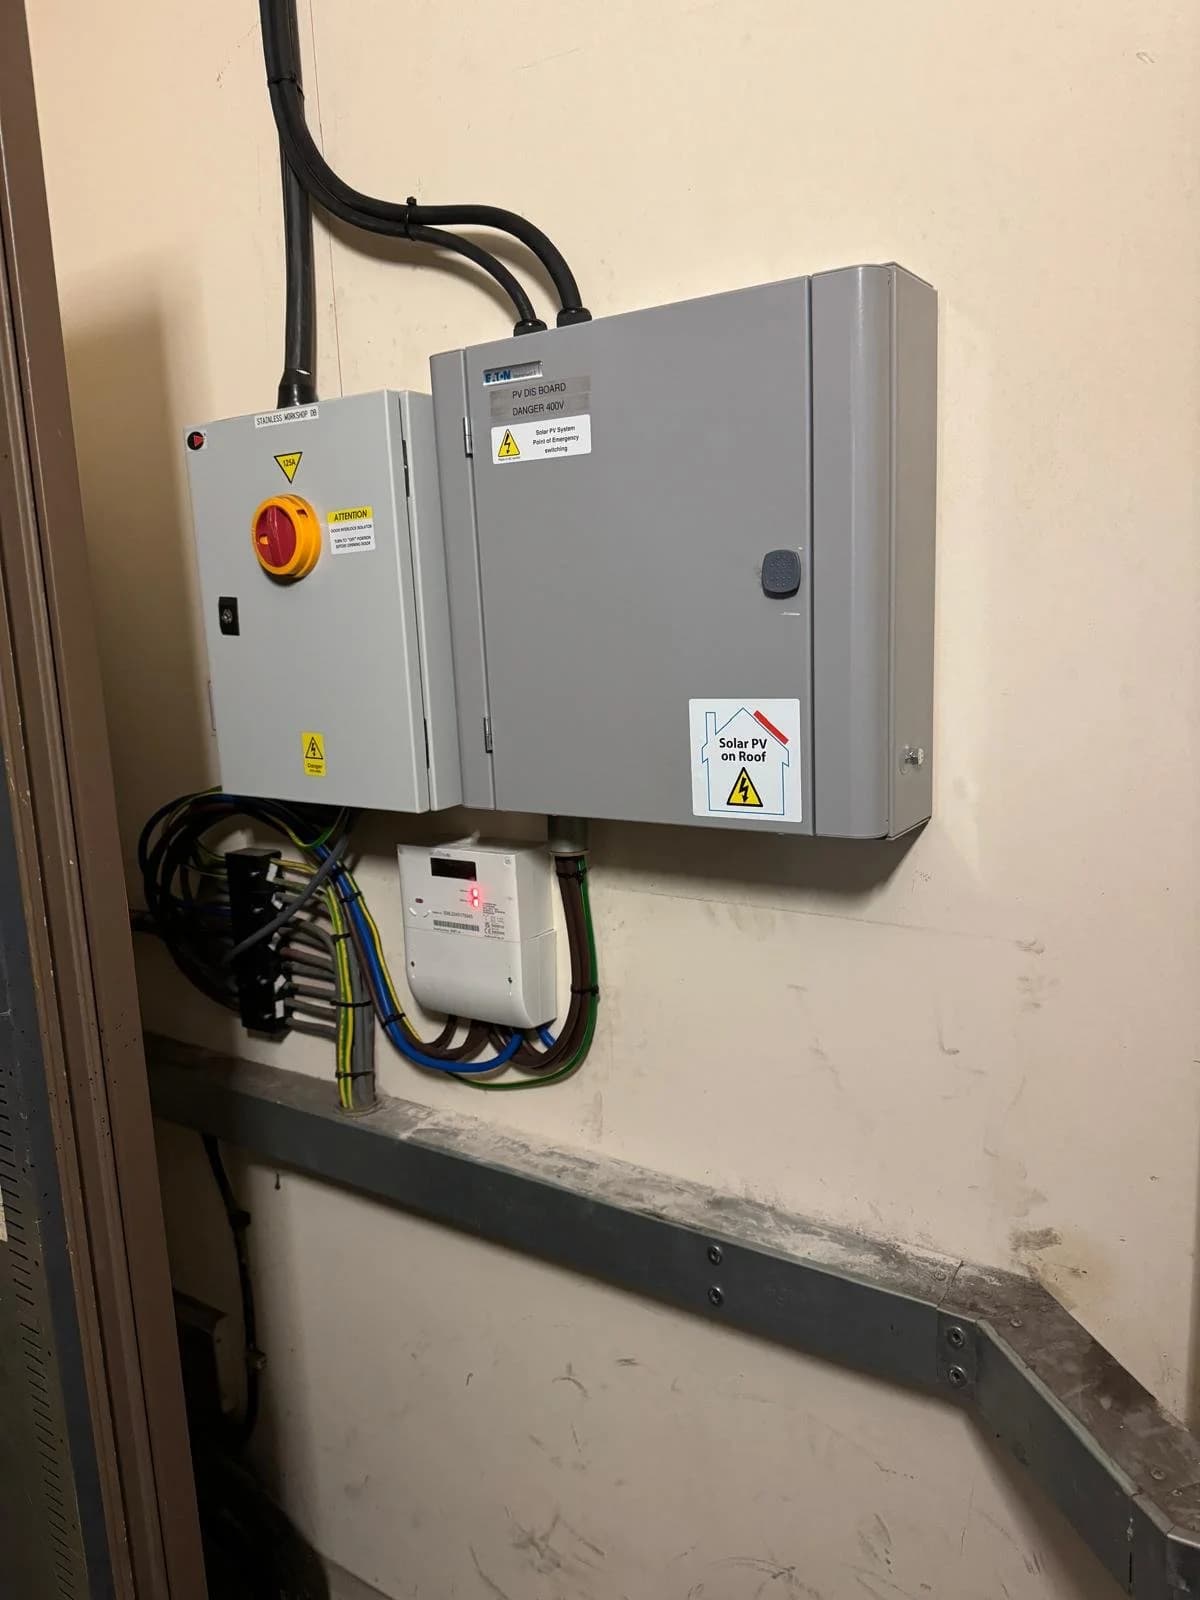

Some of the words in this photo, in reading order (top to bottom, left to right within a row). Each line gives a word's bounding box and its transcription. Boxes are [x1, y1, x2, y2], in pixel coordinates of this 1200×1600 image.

[512, 390, 523, 400] PV
[524, 387, 537, 398] DIS
[538, 382, 567, 395] BOARD
[512, 403, 545, 416] DANGER
[546, 400, 565, 412] 400V
[256, 414, 282, 426] STAINLESS
[284, 410, 308, 421] WORKSHOP
[557, 425, 576, 434] System
[552, 434, 580, 443] Emergency
[544, 446, 568, 454] switching
[282, 459, 296, 468] 125A
[334, 509, 368, 521] ATTENTION
[719, 737, 749, 749] Solar
[752, 738, 768, 750] PV
[721, 752, 736, 761] on
[738, 750, 767, 763] Roof
